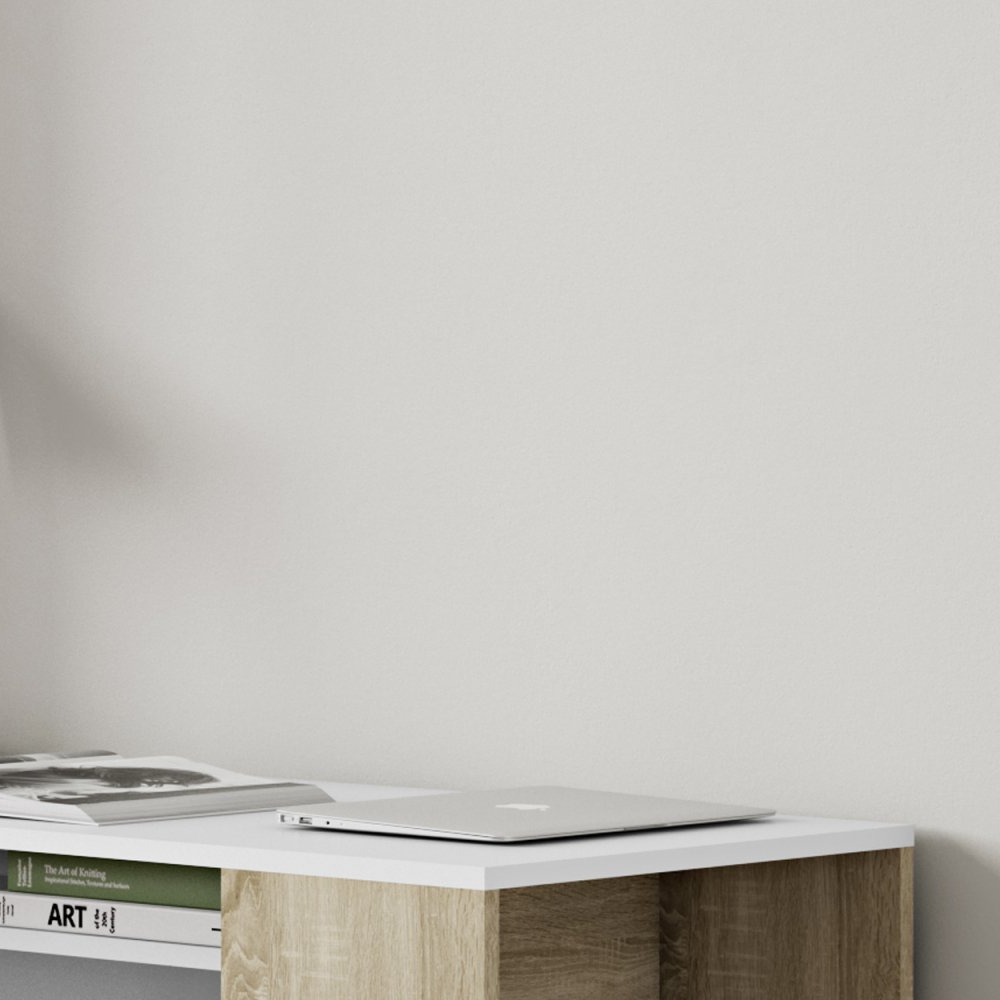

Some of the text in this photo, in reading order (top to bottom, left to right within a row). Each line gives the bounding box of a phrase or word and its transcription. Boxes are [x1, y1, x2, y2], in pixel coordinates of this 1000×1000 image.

[44, 865, 107, 882] The Art of Knitting
[47, 903, 87, 929] ART
